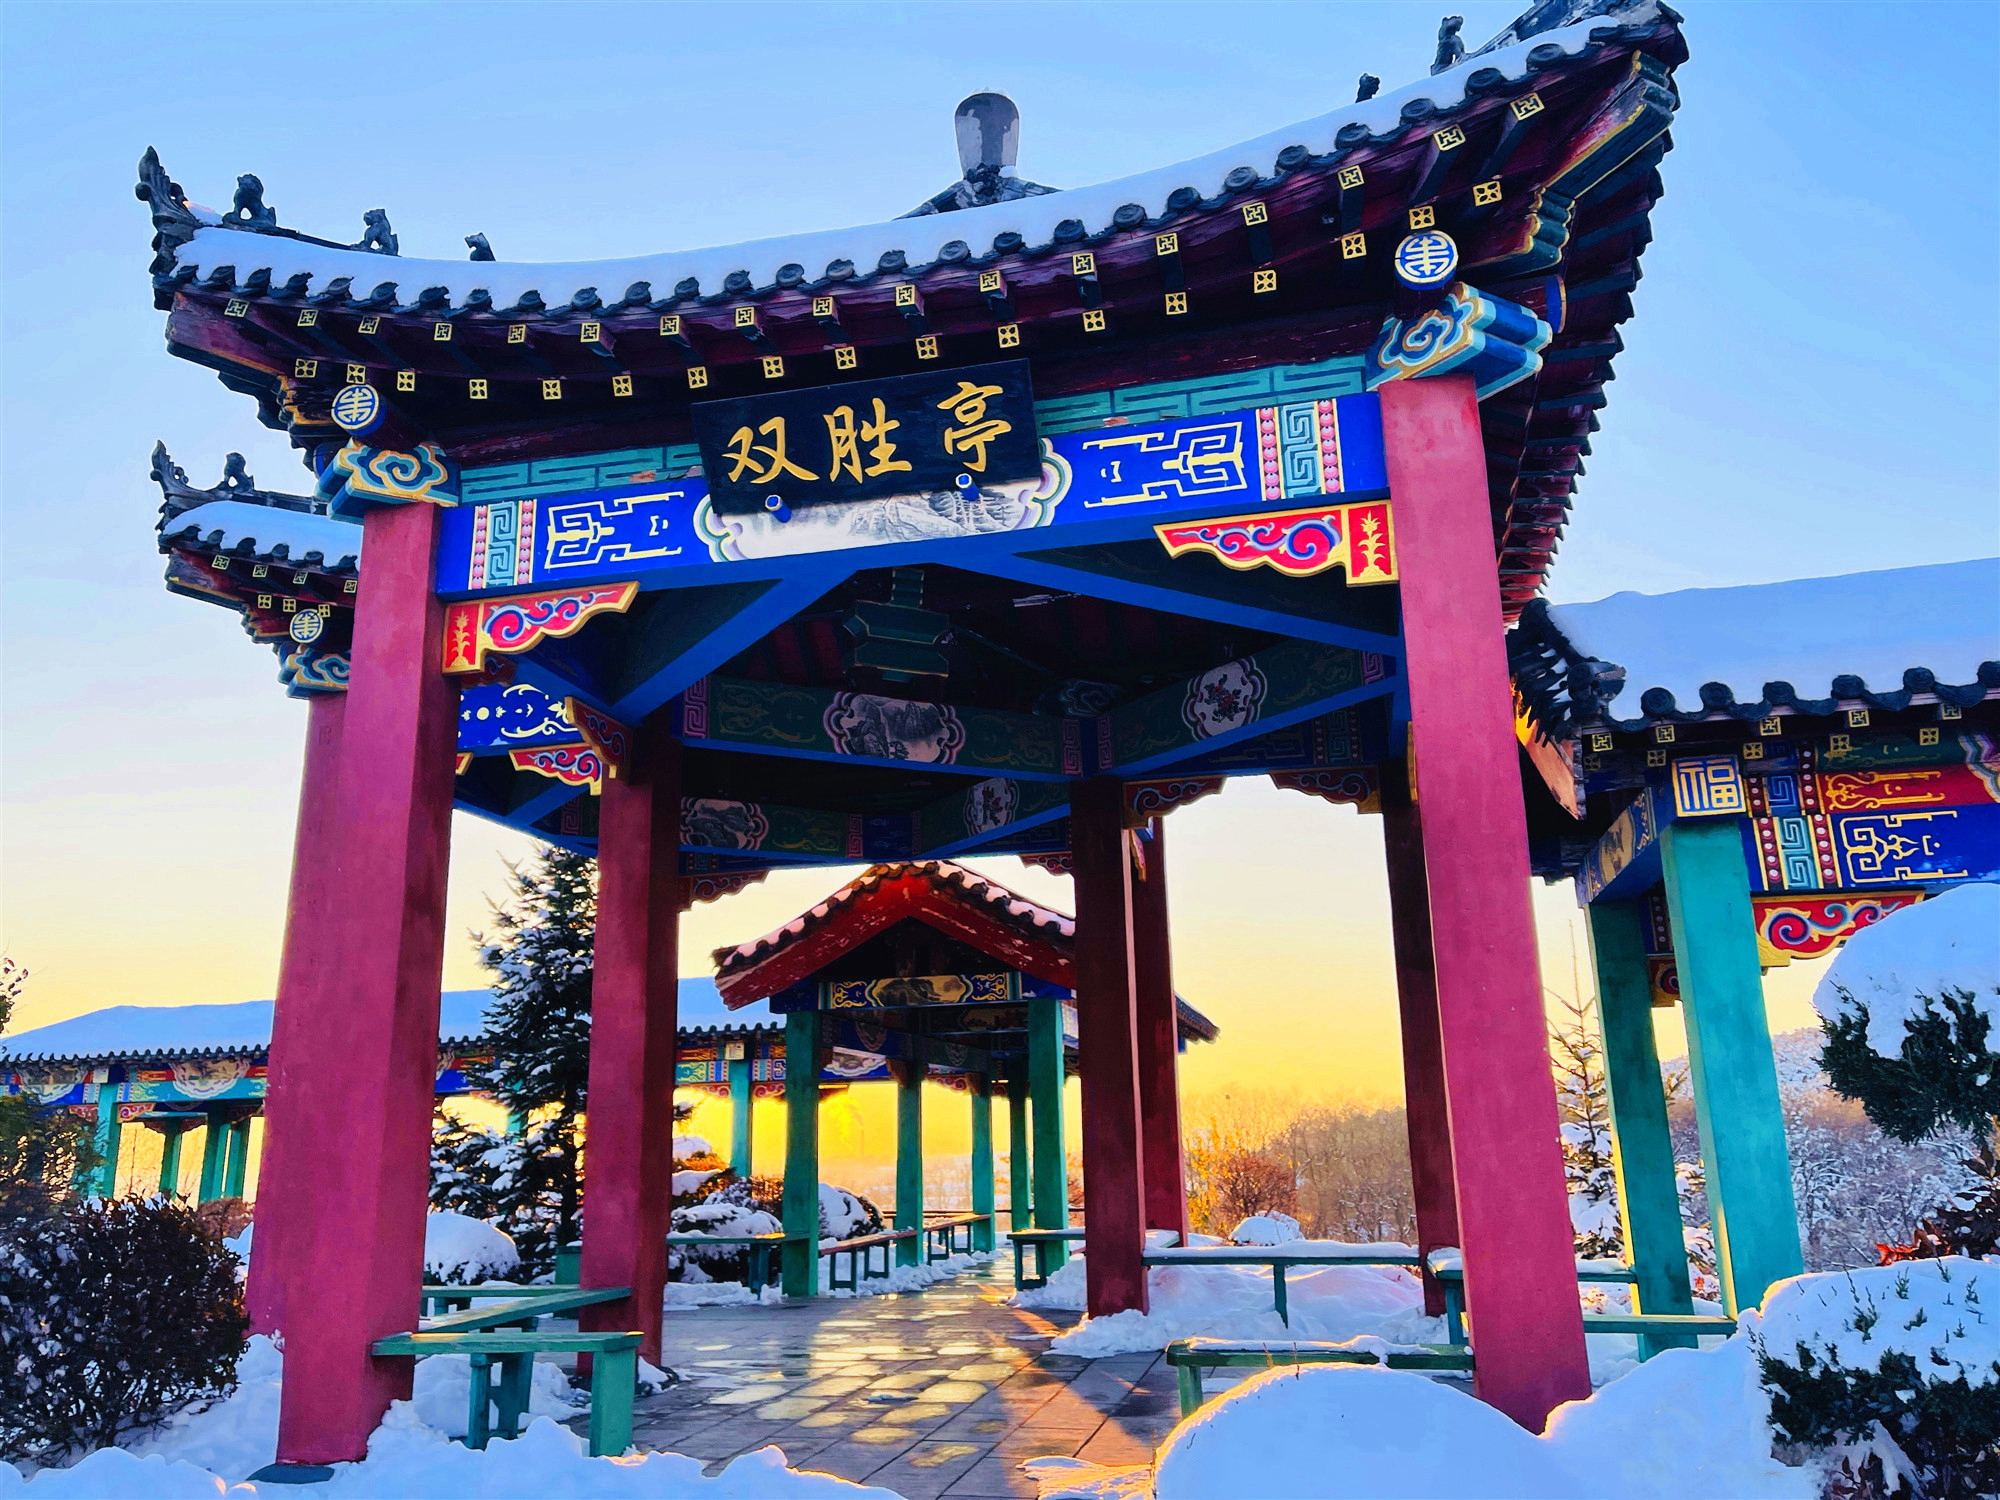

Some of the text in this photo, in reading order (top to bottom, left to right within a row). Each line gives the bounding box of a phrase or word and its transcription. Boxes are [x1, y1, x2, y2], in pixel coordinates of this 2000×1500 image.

[722, 381, 1012, 484] 双胜亭
[1678, 758, 1739, 810] 福
